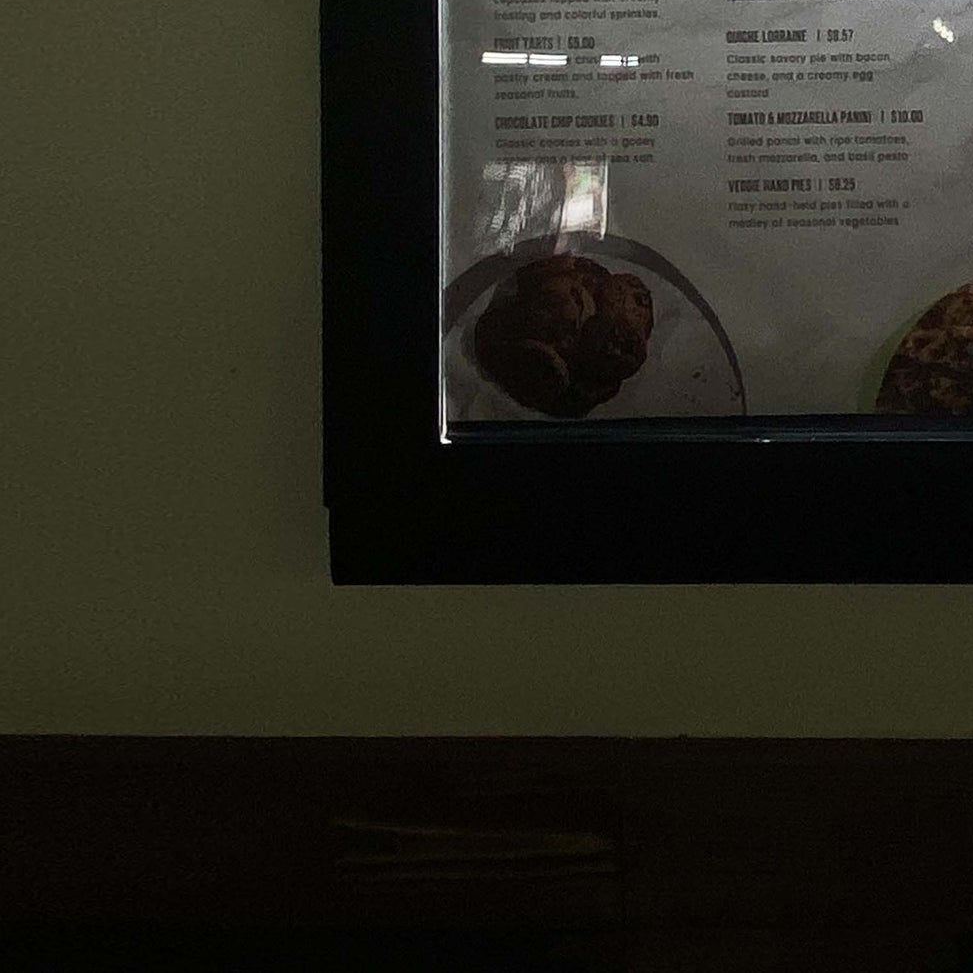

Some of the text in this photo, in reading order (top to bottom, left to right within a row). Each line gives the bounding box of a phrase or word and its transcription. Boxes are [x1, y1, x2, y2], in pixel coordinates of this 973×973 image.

[540, 11, 561, 20] and
[564, 10, 606, 19] colorful
[726, 31, 759, 43] QUICHE
[762, 30, 807, 42] LORRAINE
[494, 37, 520, 50] FRUIT
[523, 37, 553, 50] TARTS
[727, 53, 852, 64] Classic savory pie with
[572, 72, 593, 81] and
[640, 71, 663, 81] with
[666, 69, 694, 80] fresh
[772, 72, 873, 82] and a creamy egg
[495, 115, 549, 129] CHOCOLATE
[552, 115, 573, 128] CHIP
[575, 115, 614, 128] COOKIES
[727, 112, 765, 125] TOMATO
[768, 112, 774, 125] &
[777, 111, 838, 125] MOZZARELLA
[840, 111, 872, 124] PANINI
[804, 136, 826, 145] with
[824, 152, 845, 162] and
[728, 179, 760, 193] VEGGIE
[764, 179, 789, 192] HAND
[792, 179, 811, 191] PIES
